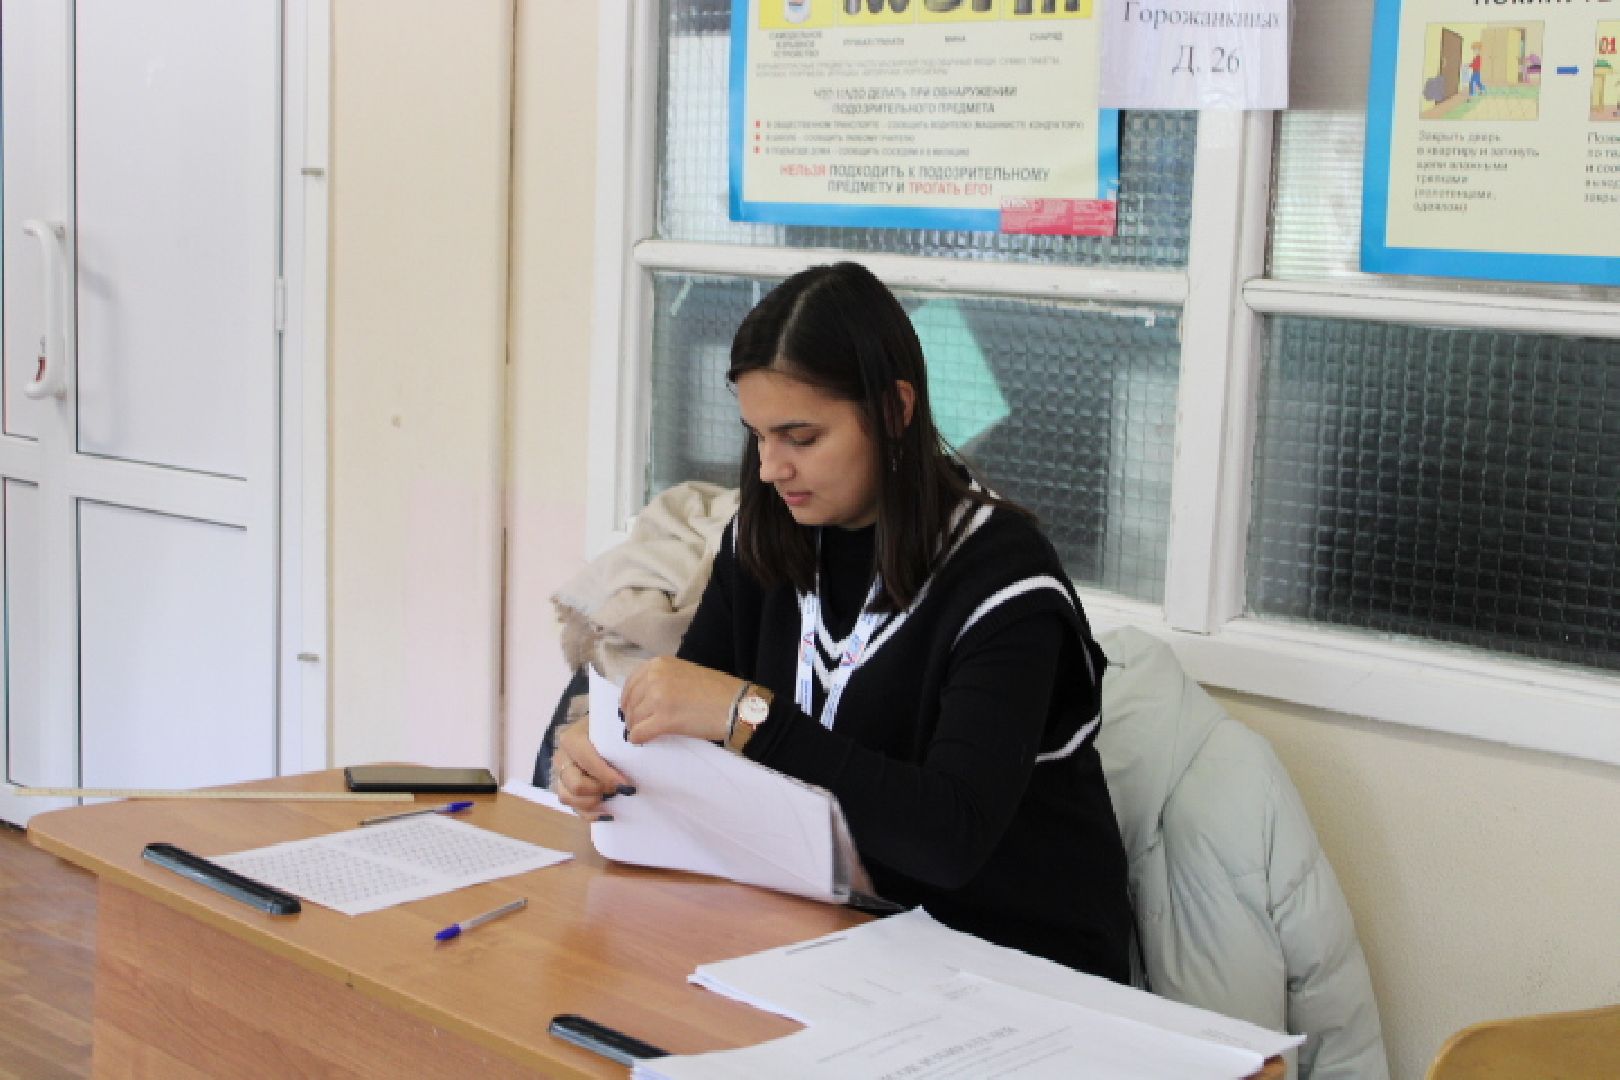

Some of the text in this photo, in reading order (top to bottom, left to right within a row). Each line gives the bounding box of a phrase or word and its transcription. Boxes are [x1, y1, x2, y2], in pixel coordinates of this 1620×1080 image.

[1171, 45, 1240, 76] Д. 26
[867, 87, 907, 99] ДЕЛАТЬ
[910, 86, 931, 97] ПРИ
[933, 86, 1018, 98] ОБНАРУЖЕНИИ
[832, 102, 995, 115] ПОДОЗРИТЕЛЬНОГО ПРЕДМЕТА
[780, 164, 826, 176] НЕЛЬЗЯ
[829, 165, 905, 178] ПОДХОДИТЬ
[919, 166, 1050, 181] ПОДОЗРИТЕЛЬНОМУ
[828, 180, 993, 195] ПРЕДМЕТУ И ТРОГАТЬ ЕГО!
